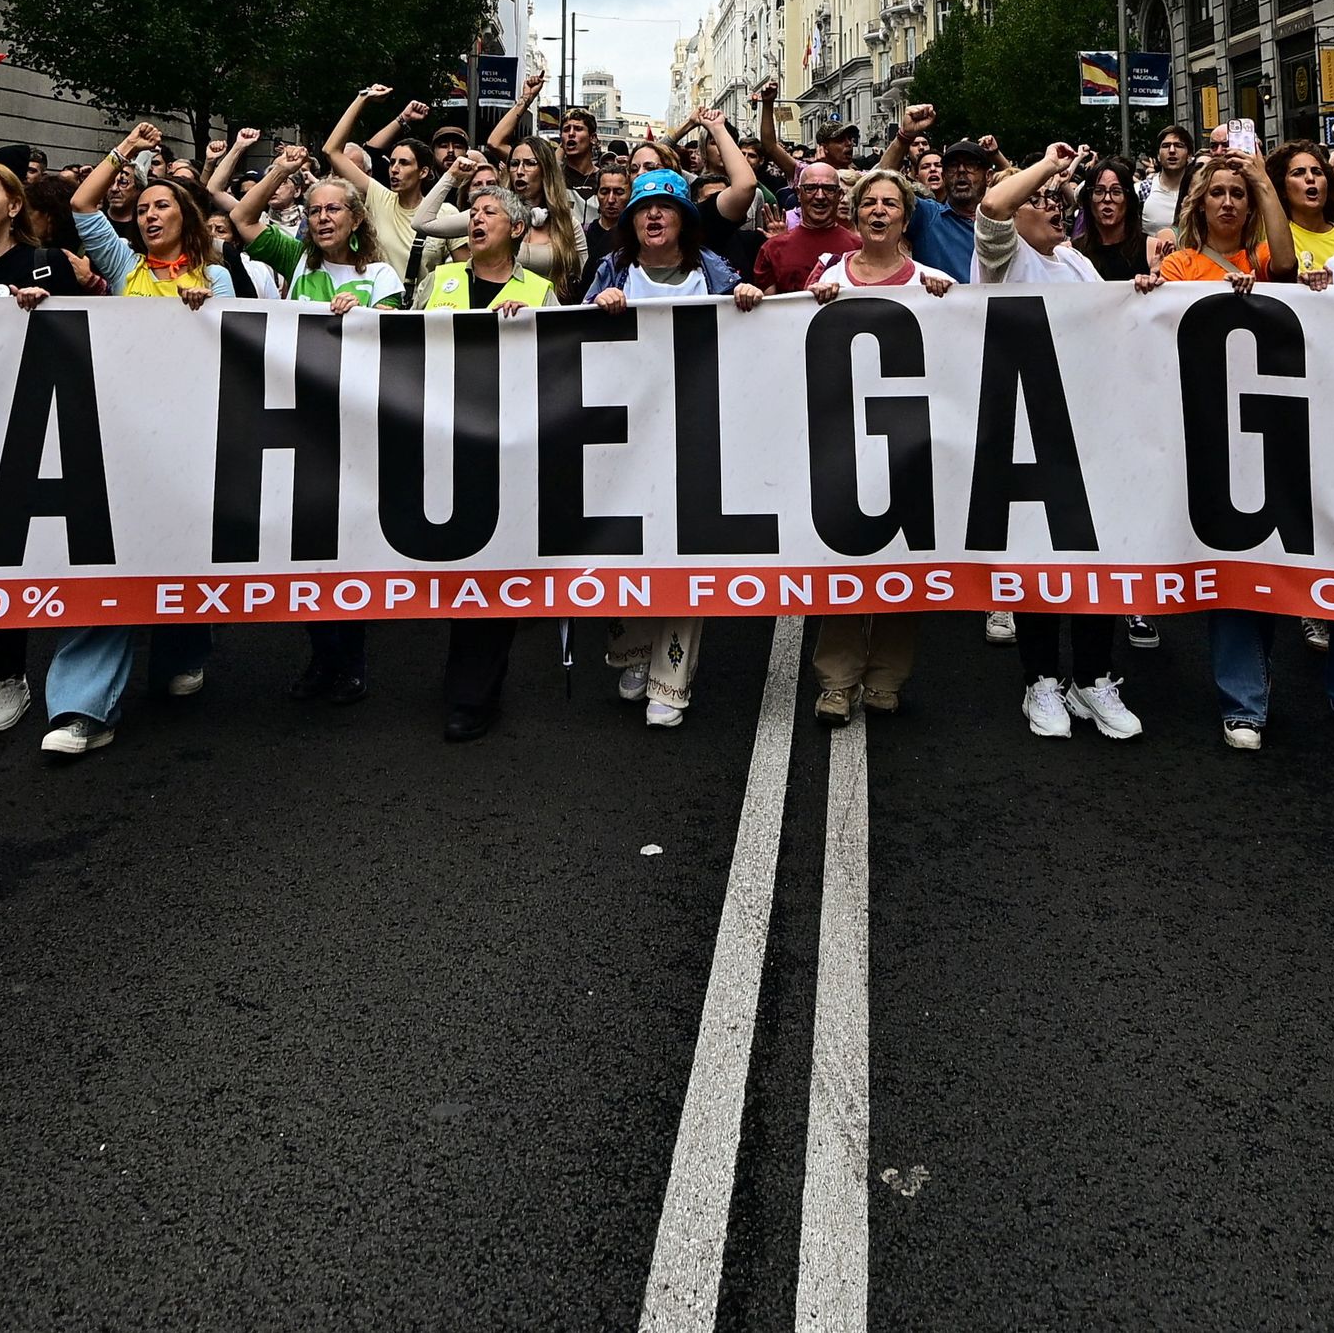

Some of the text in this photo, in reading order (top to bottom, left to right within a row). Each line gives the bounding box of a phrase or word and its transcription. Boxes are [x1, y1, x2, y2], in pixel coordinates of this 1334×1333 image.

[212, 297, 1099, 563] HUELGA
[157, 567, 651, 614] EXPROPIACIÓN
[690, 570, 955, 607] FONDOS
[992, 568, 1218, 604] BUITRE
